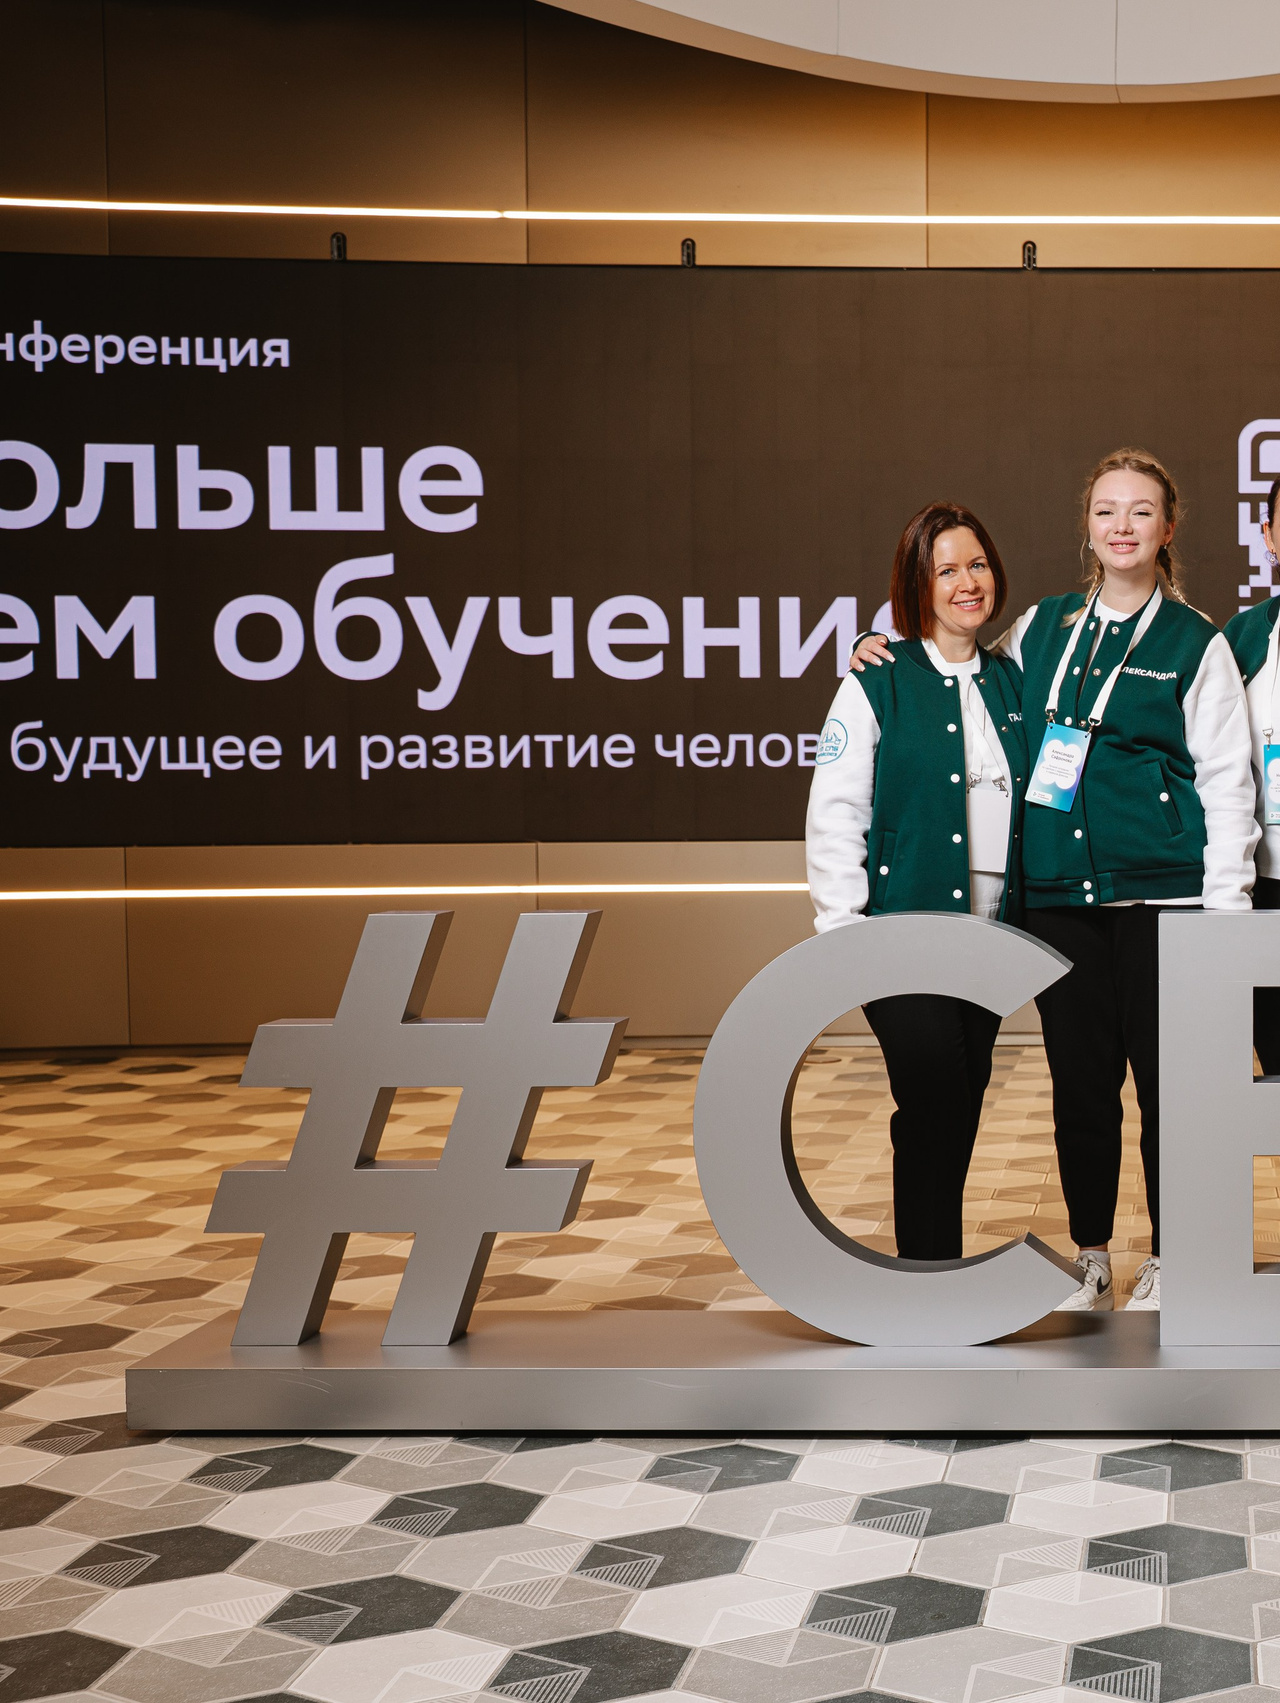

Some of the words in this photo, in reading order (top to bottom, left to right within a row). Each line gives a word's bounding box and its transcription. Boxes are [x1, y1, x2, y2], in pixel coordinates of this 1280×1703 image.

[213, 553, 893, 710] обучени
[10, 720, 283, 783] будущее
[304, 735, 338, 770] и
[360, 733, 636, 780] развитие
